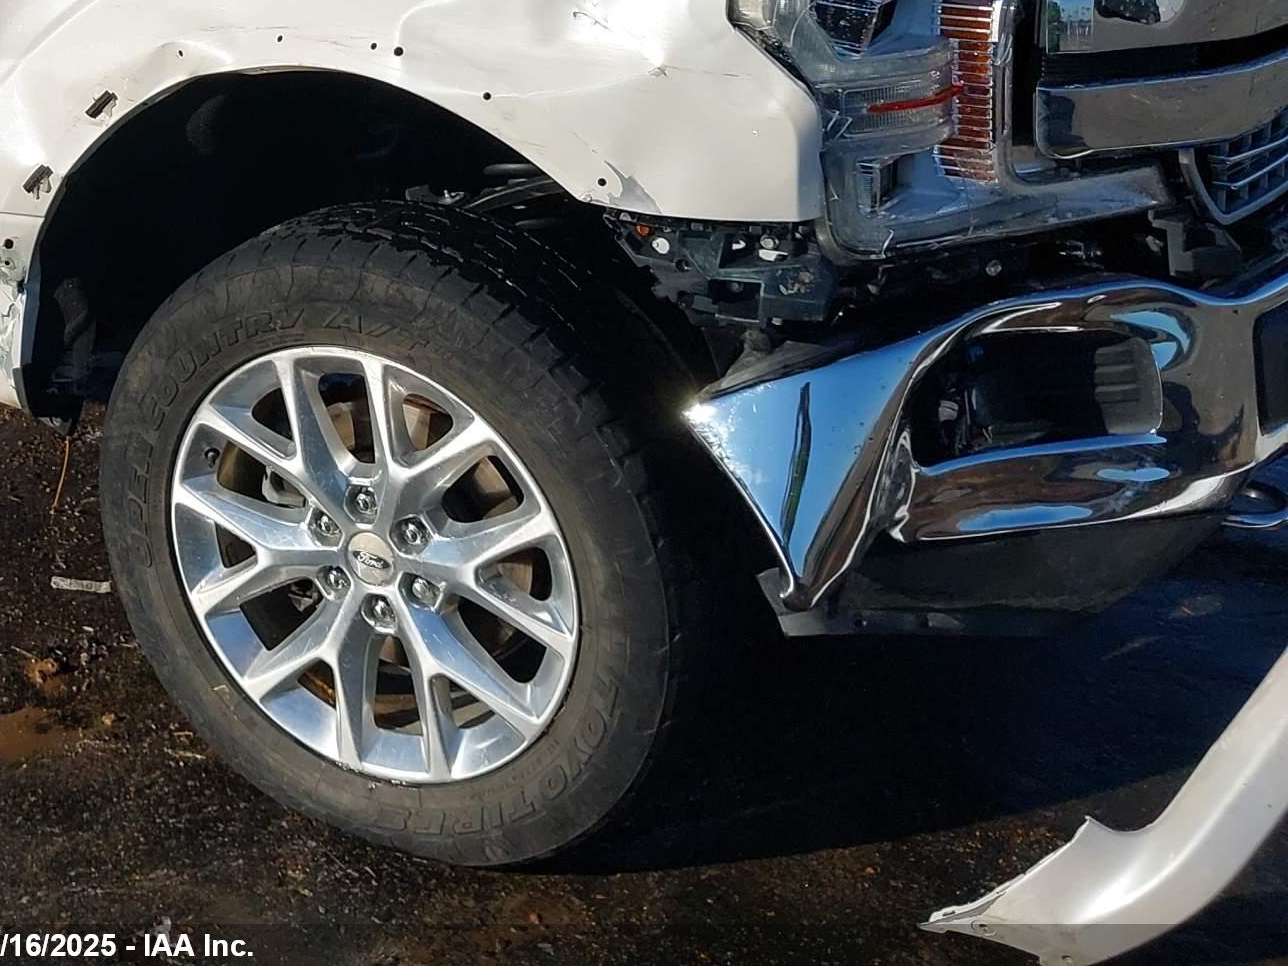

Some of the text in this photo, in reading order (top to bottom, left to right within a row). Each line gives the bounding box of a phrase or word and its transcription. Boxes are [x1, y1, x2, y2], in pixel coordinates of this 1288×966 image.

[147, 308, 304, 431] COUNTRY
[357, 551, 385, 569] Ford
[538, 679, 620, 801] TOYO
[373, 791, 536, 836] TIRES
